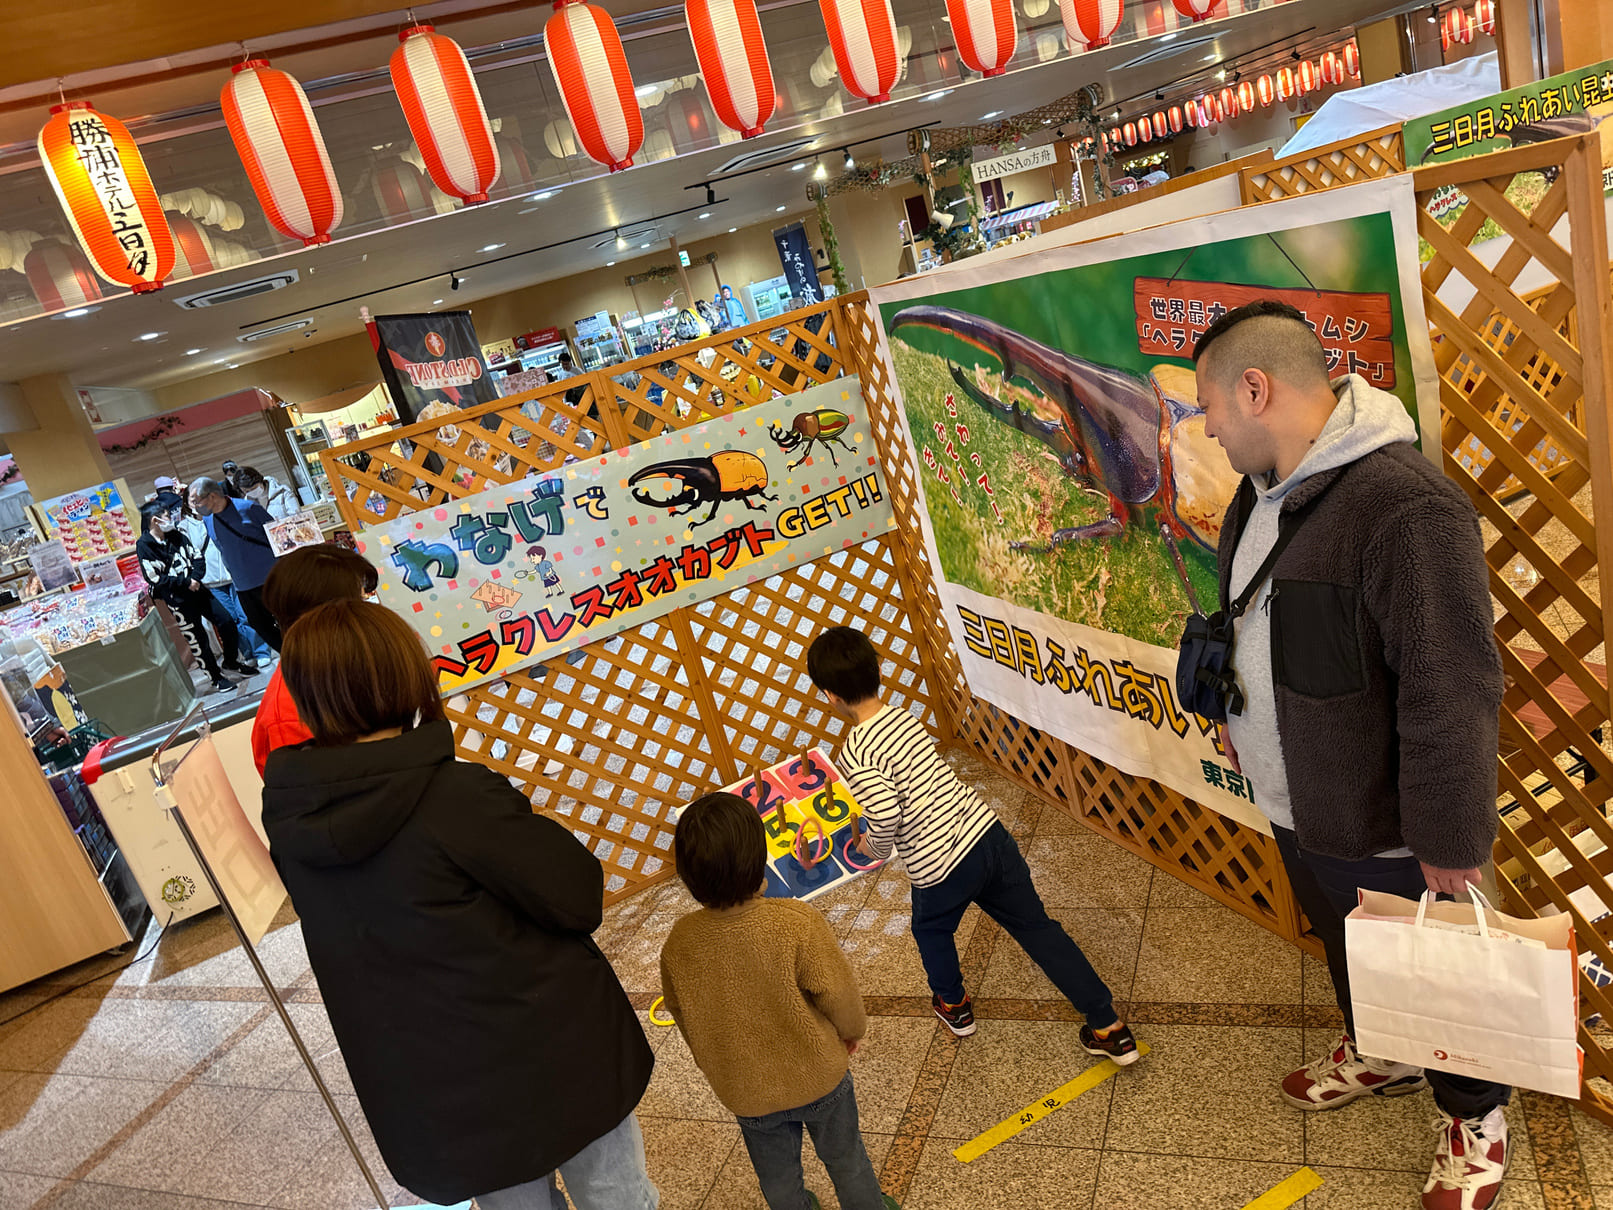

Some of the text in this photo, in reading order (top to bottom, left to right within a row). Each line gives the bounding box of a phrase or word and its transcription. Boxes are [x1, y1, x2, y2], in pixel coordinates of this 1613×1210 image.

[67, 117, 151, 276] 勝浦ホテル三日月
[788, 758, 827, 791] 3
[811, 791, 850, 823] 6
